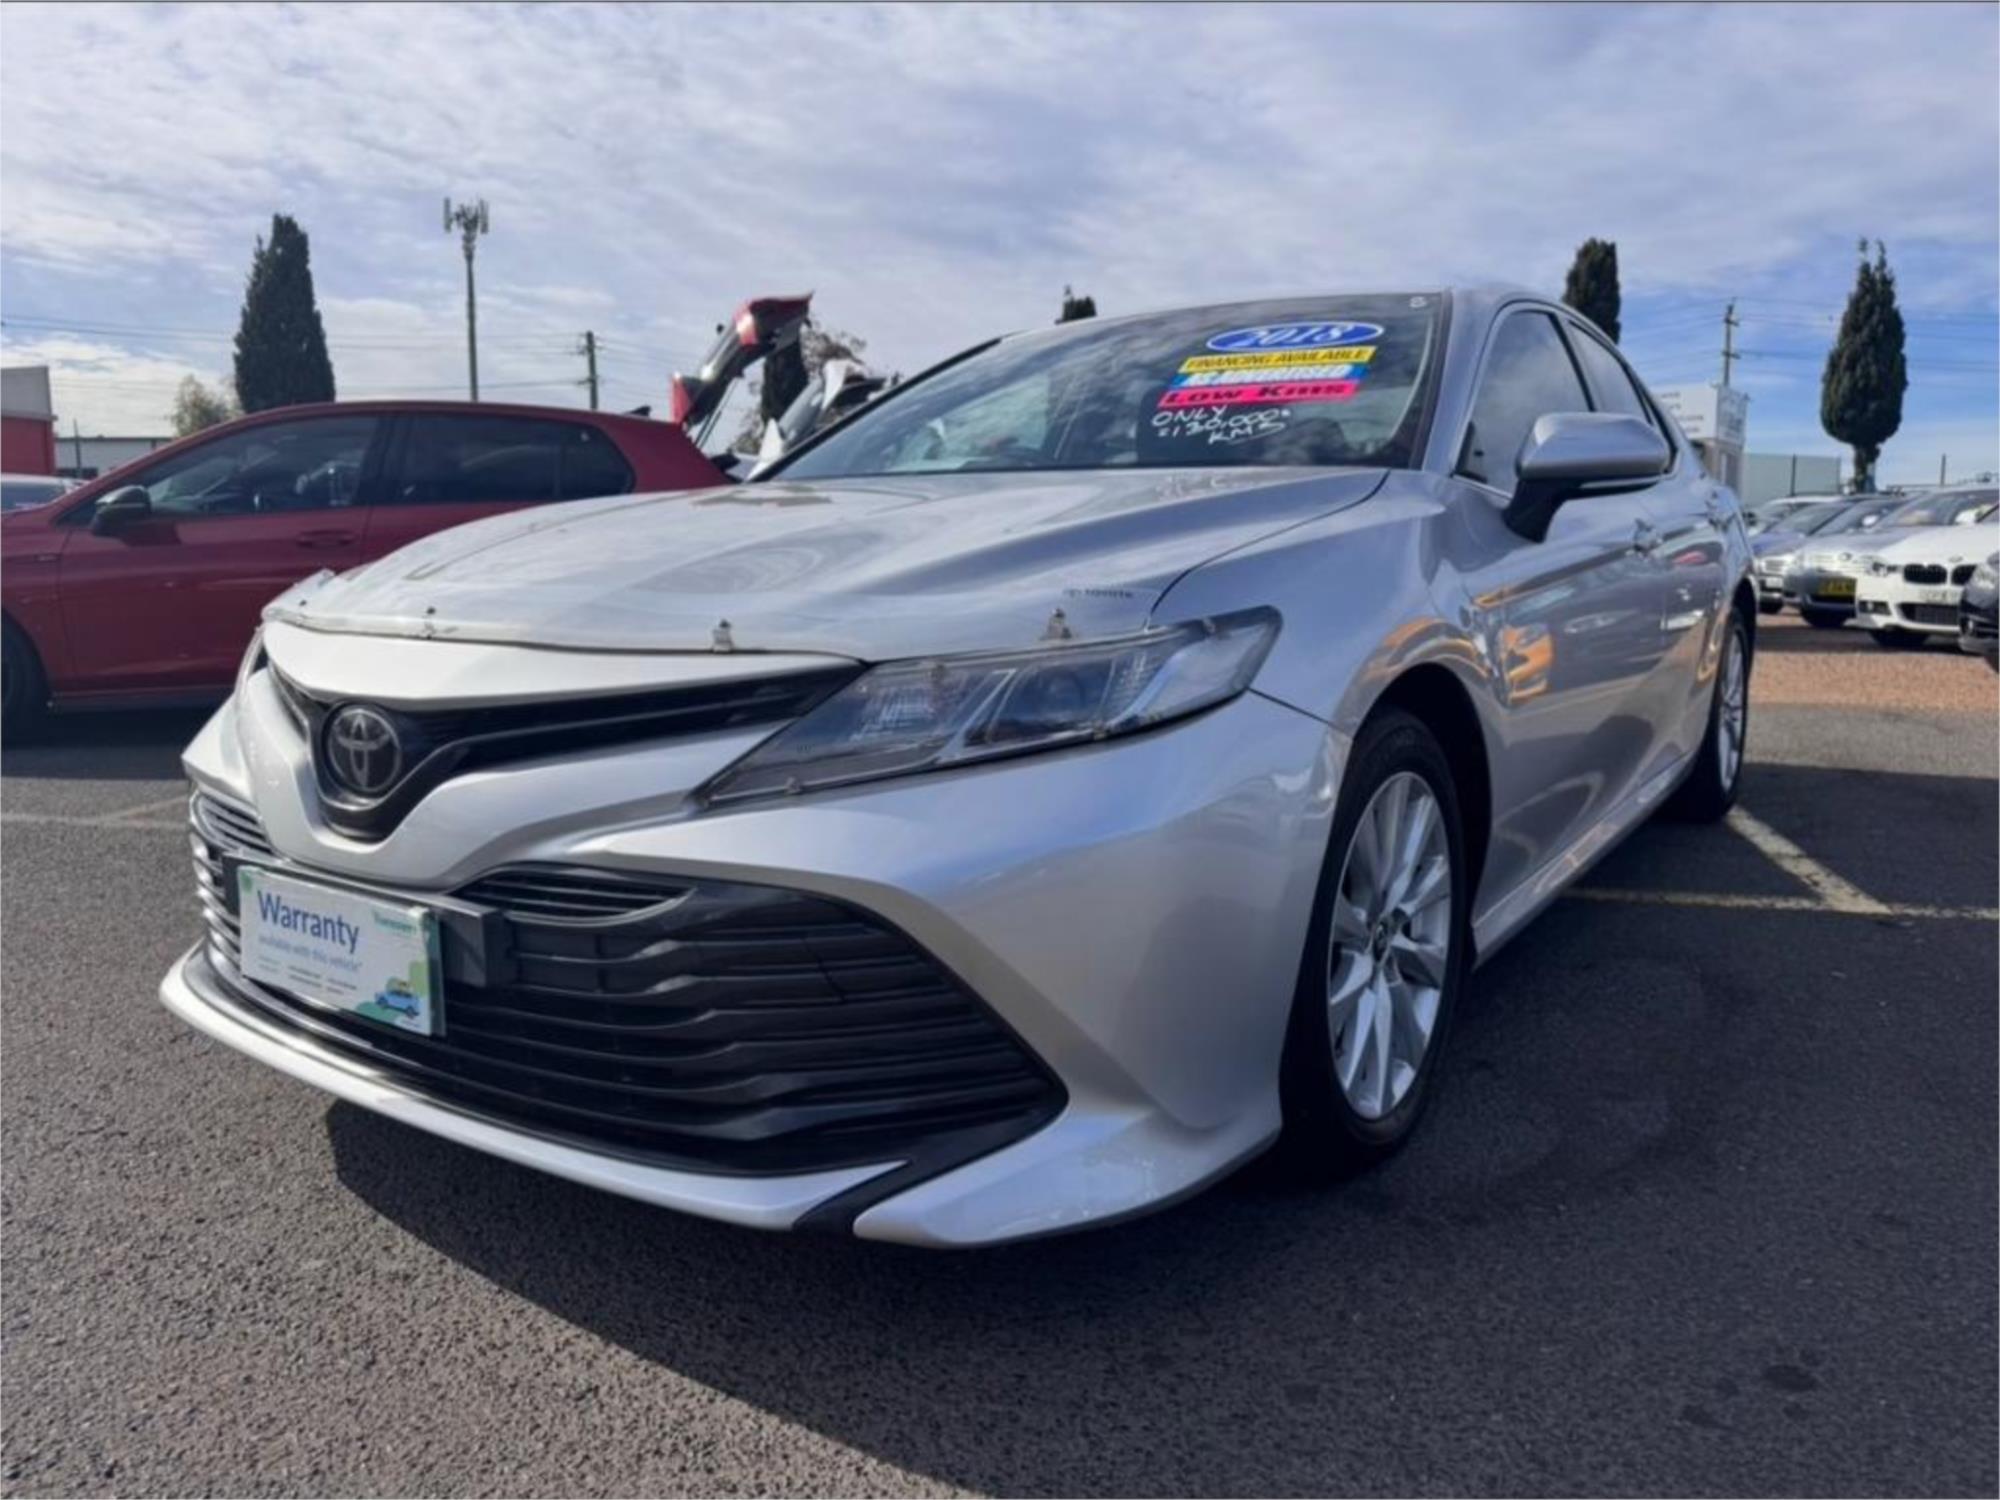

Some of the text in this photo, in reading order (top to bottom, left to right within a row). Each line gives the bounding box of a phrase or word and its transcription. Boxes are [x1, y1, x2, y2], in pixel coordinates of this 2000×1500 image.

[1228, 324, 1356, 348] 2018
[1152, 404, 1228, 426] ONLY
[257, 890, 360, 954] Warranty
